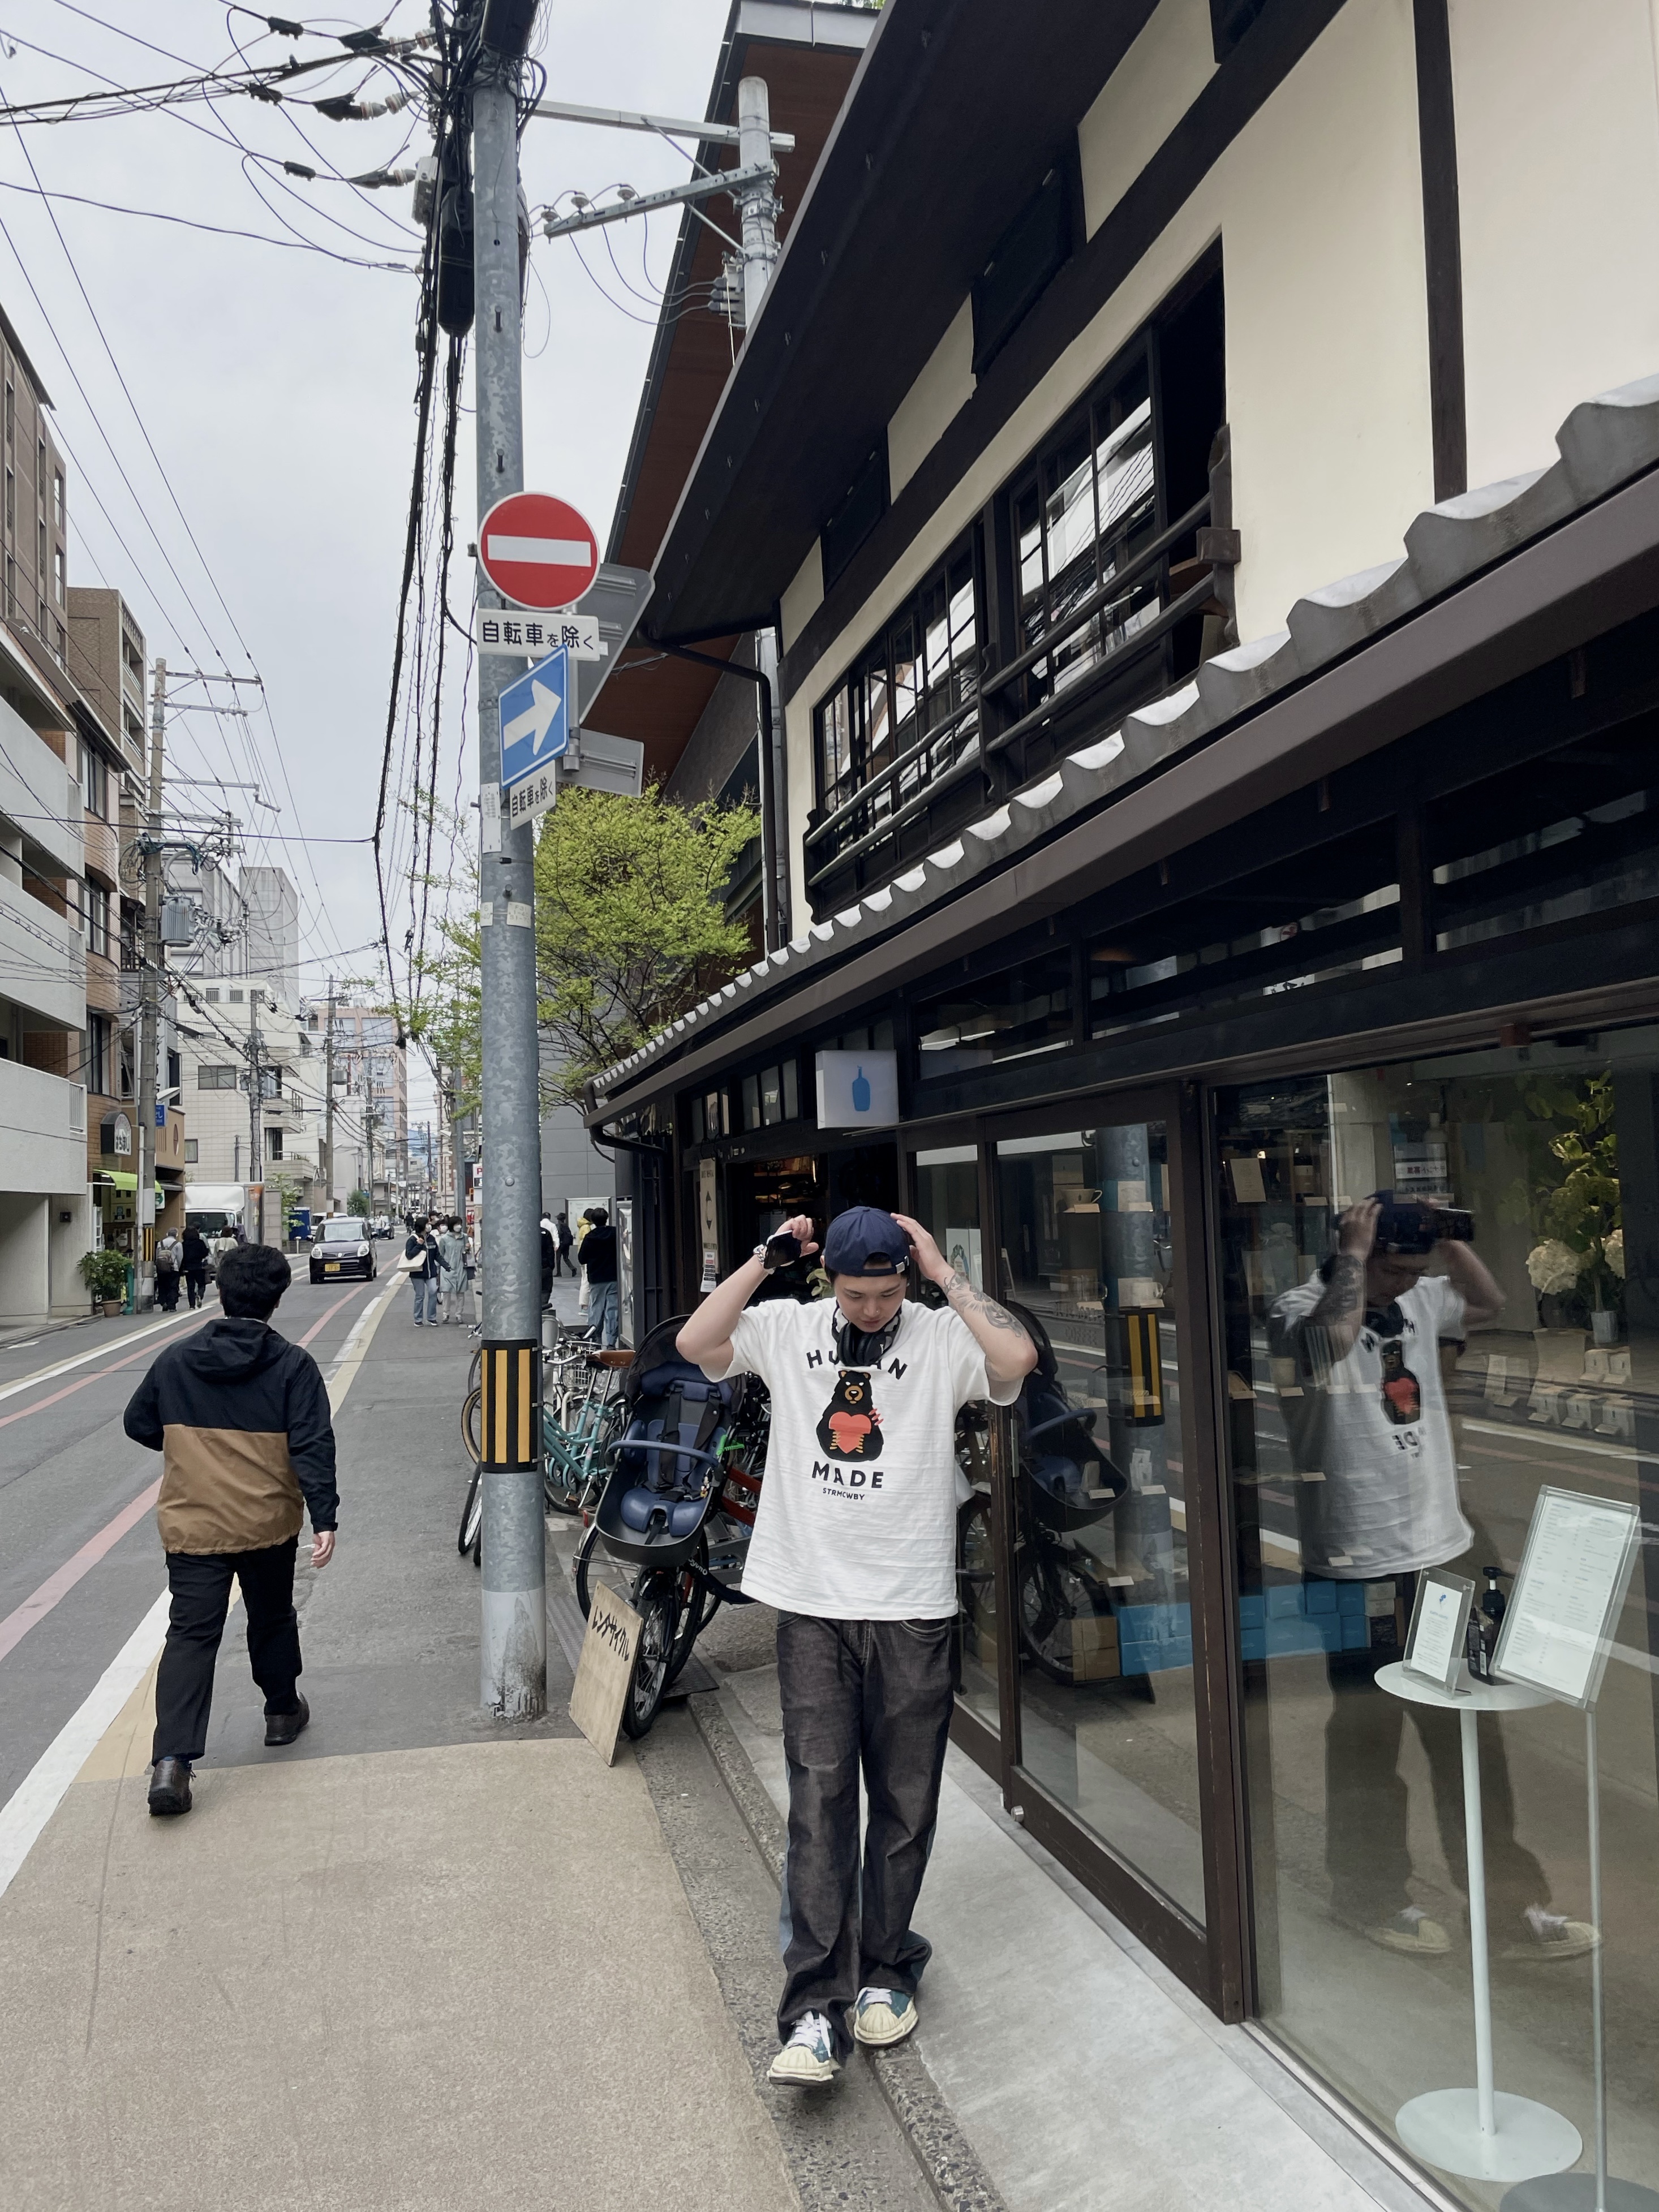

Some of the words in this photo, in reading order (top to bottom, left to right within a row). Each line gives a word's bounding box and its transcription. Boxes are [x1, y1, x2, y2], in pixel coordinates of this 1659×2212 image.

[482, 619, 594, 650] 自転車を除く
[512, 776, 553, 818] 自転車を除く
[806, 1349, 908, 1380] HUN
[811, 1461, 884, 1488] MADE
[823, 1487, 865, 1500] STRMCWBY
[592, 1606, 630, 1662] レンタサイクル
